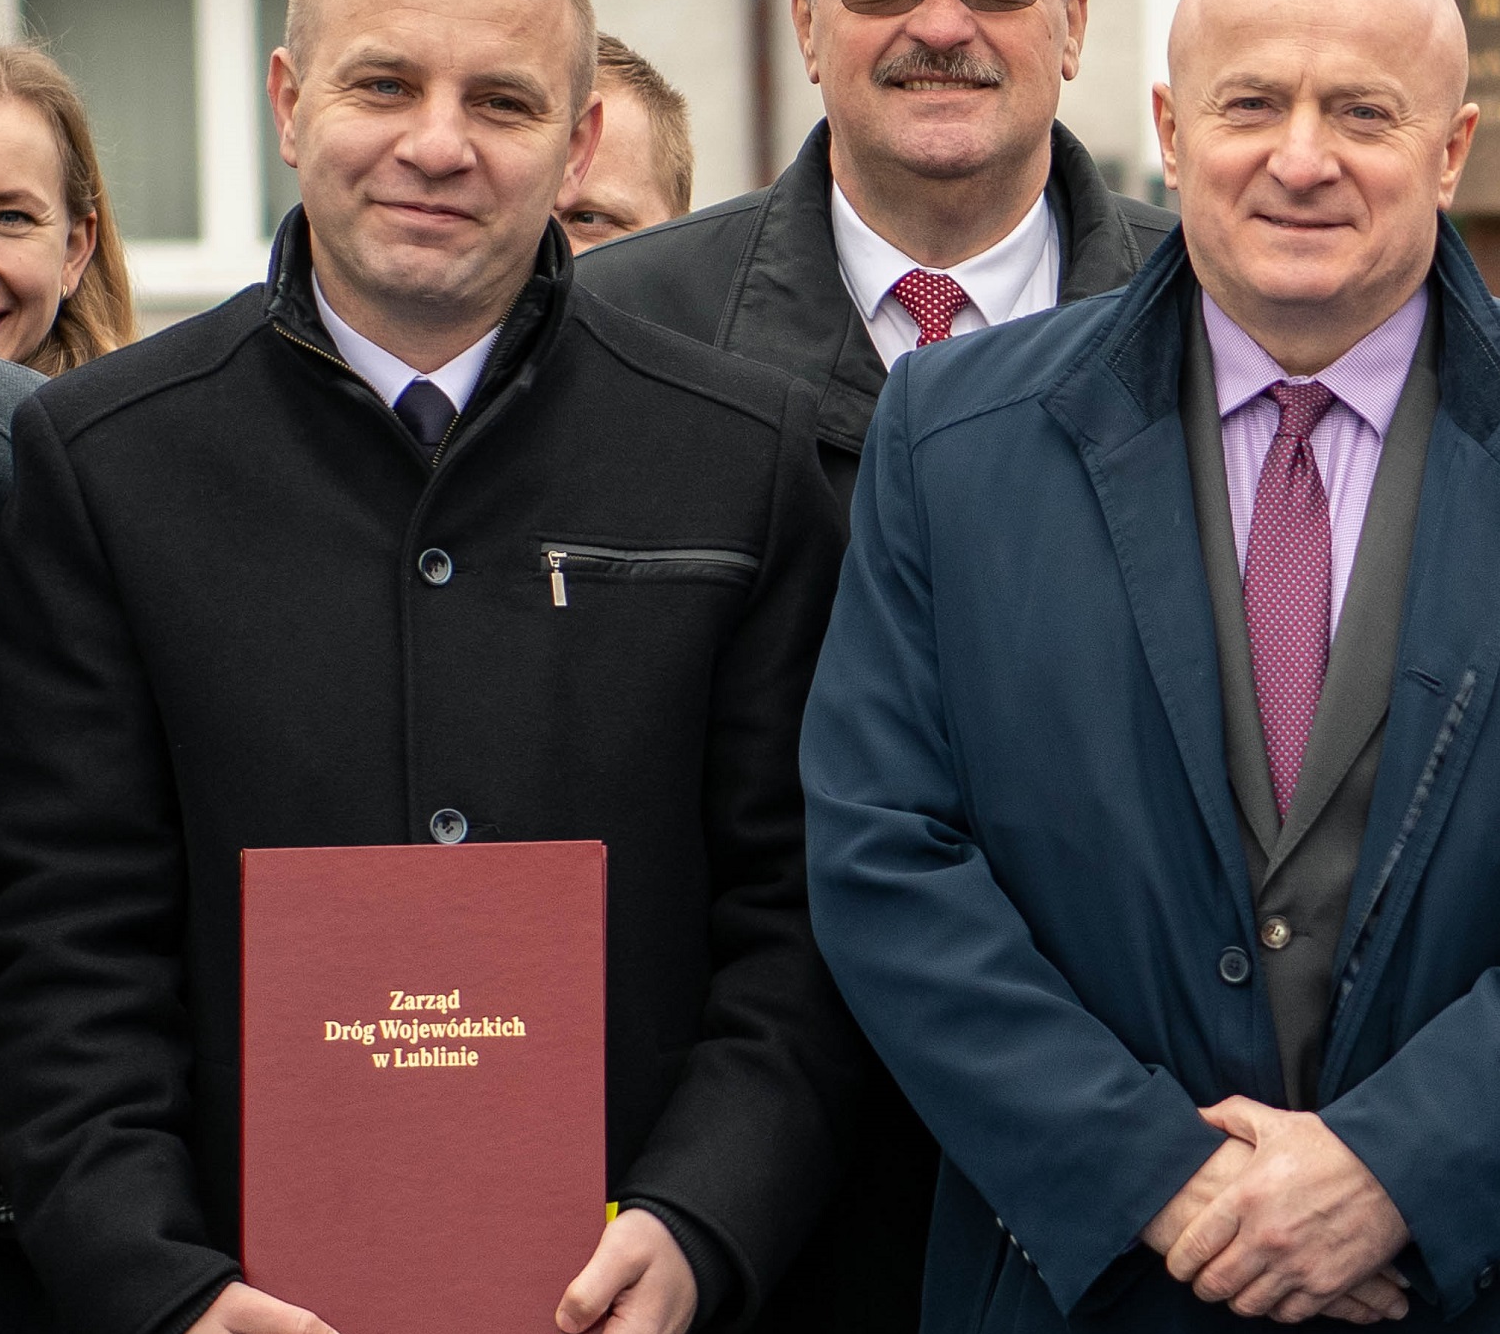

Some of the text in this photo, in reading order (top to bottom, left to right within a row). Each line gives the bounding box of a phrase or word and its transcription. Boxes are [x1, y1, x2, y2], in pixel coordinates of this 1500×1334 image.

[389, 989, 460, 1014] Zarząd
[324, 1016, 526, 1045] Dróg Wojewódzkich
[372, 1045, 479, 1067] w Lublinie
